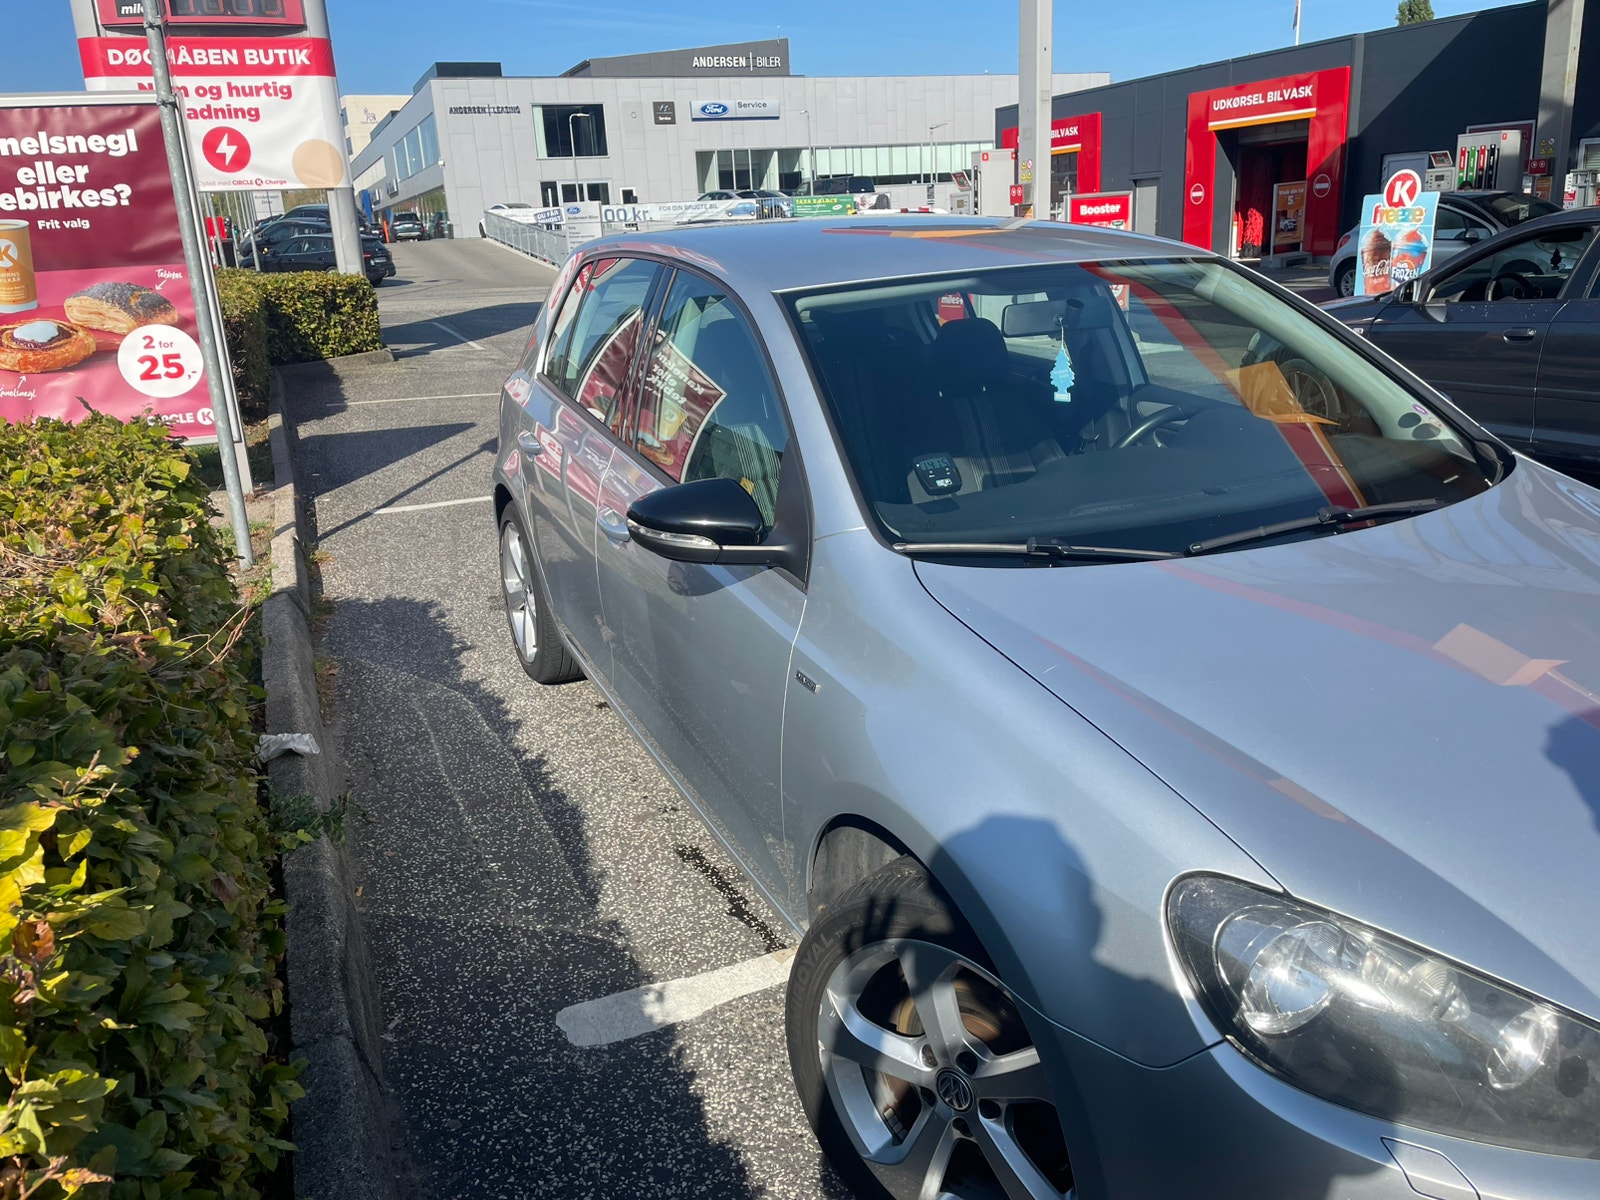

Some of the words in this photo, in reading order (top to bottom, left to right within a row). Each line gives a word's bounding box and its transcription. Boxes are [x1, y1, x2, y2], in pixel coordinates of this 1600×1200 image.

[245, 49, 311, 65] BUTIK
[692, 56, 746, 67] ANDERSEN
[757, 56, 781, 67] BILER
[194, 84, 222, 100] og
[226, 81, 293, 100] hurtig
[737, 101, 768, 109] Service
[1213, 93, 1264, 111] UDKØRSEL
[1267, 85, 1313, 103] BILVASK
[186, 104, 261, 122] adning
[704, 103, 725, 114] Ford
[16, 160, 90, 186] eller
[265, 178, 288, 186] Charge
[1392, 179, 1413, 207] K
[632, 206, 653, 221] kr.
[1080, 203, 1121, 215] Booster
[37, 219, 61, 230] Frit
[62, 217, 91, 229] valg
[155, 268, 182, 279] Tebirkes
[142, 335, 155, 349] 2
[159, 340, 174, 349] for
